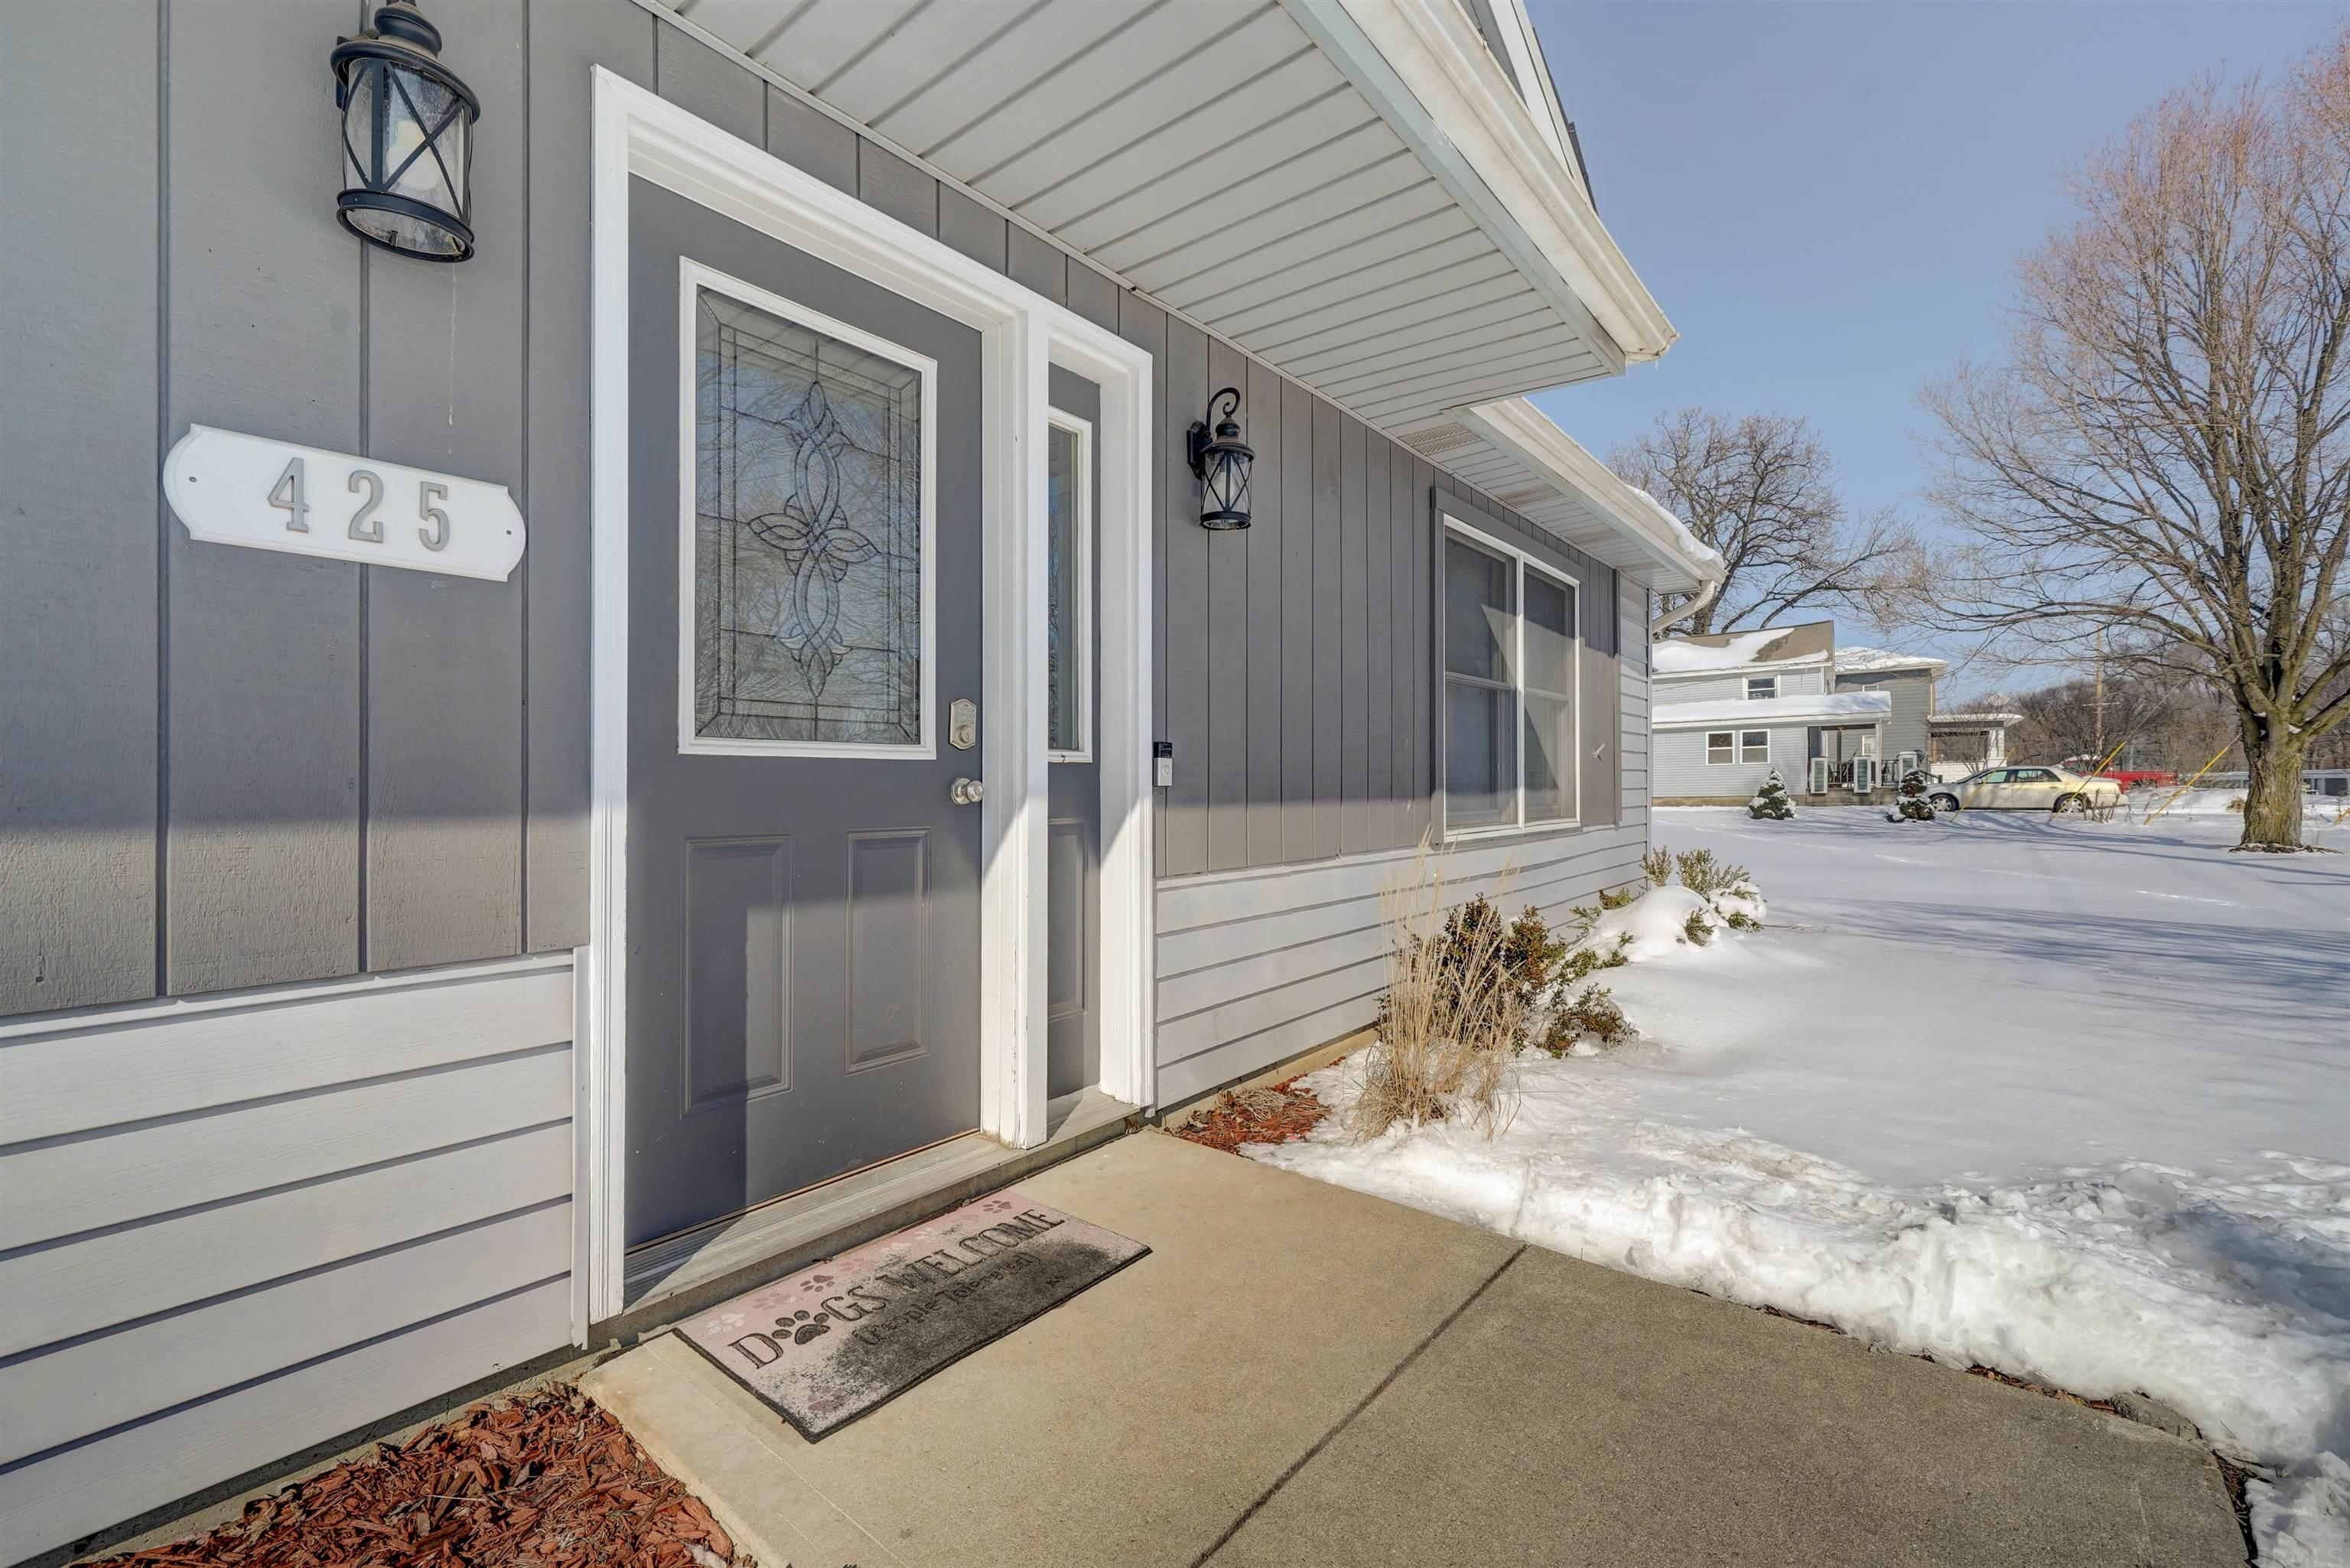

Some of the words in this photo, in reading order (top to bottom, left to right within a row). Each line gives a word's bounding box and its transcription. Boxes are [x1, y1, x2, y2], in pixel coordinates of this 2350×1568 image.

[268, 457, 450, 552] 425
[727, 1286, 887, 1369] DGS
[874, 1209, 1065, 1291] WELCOME
